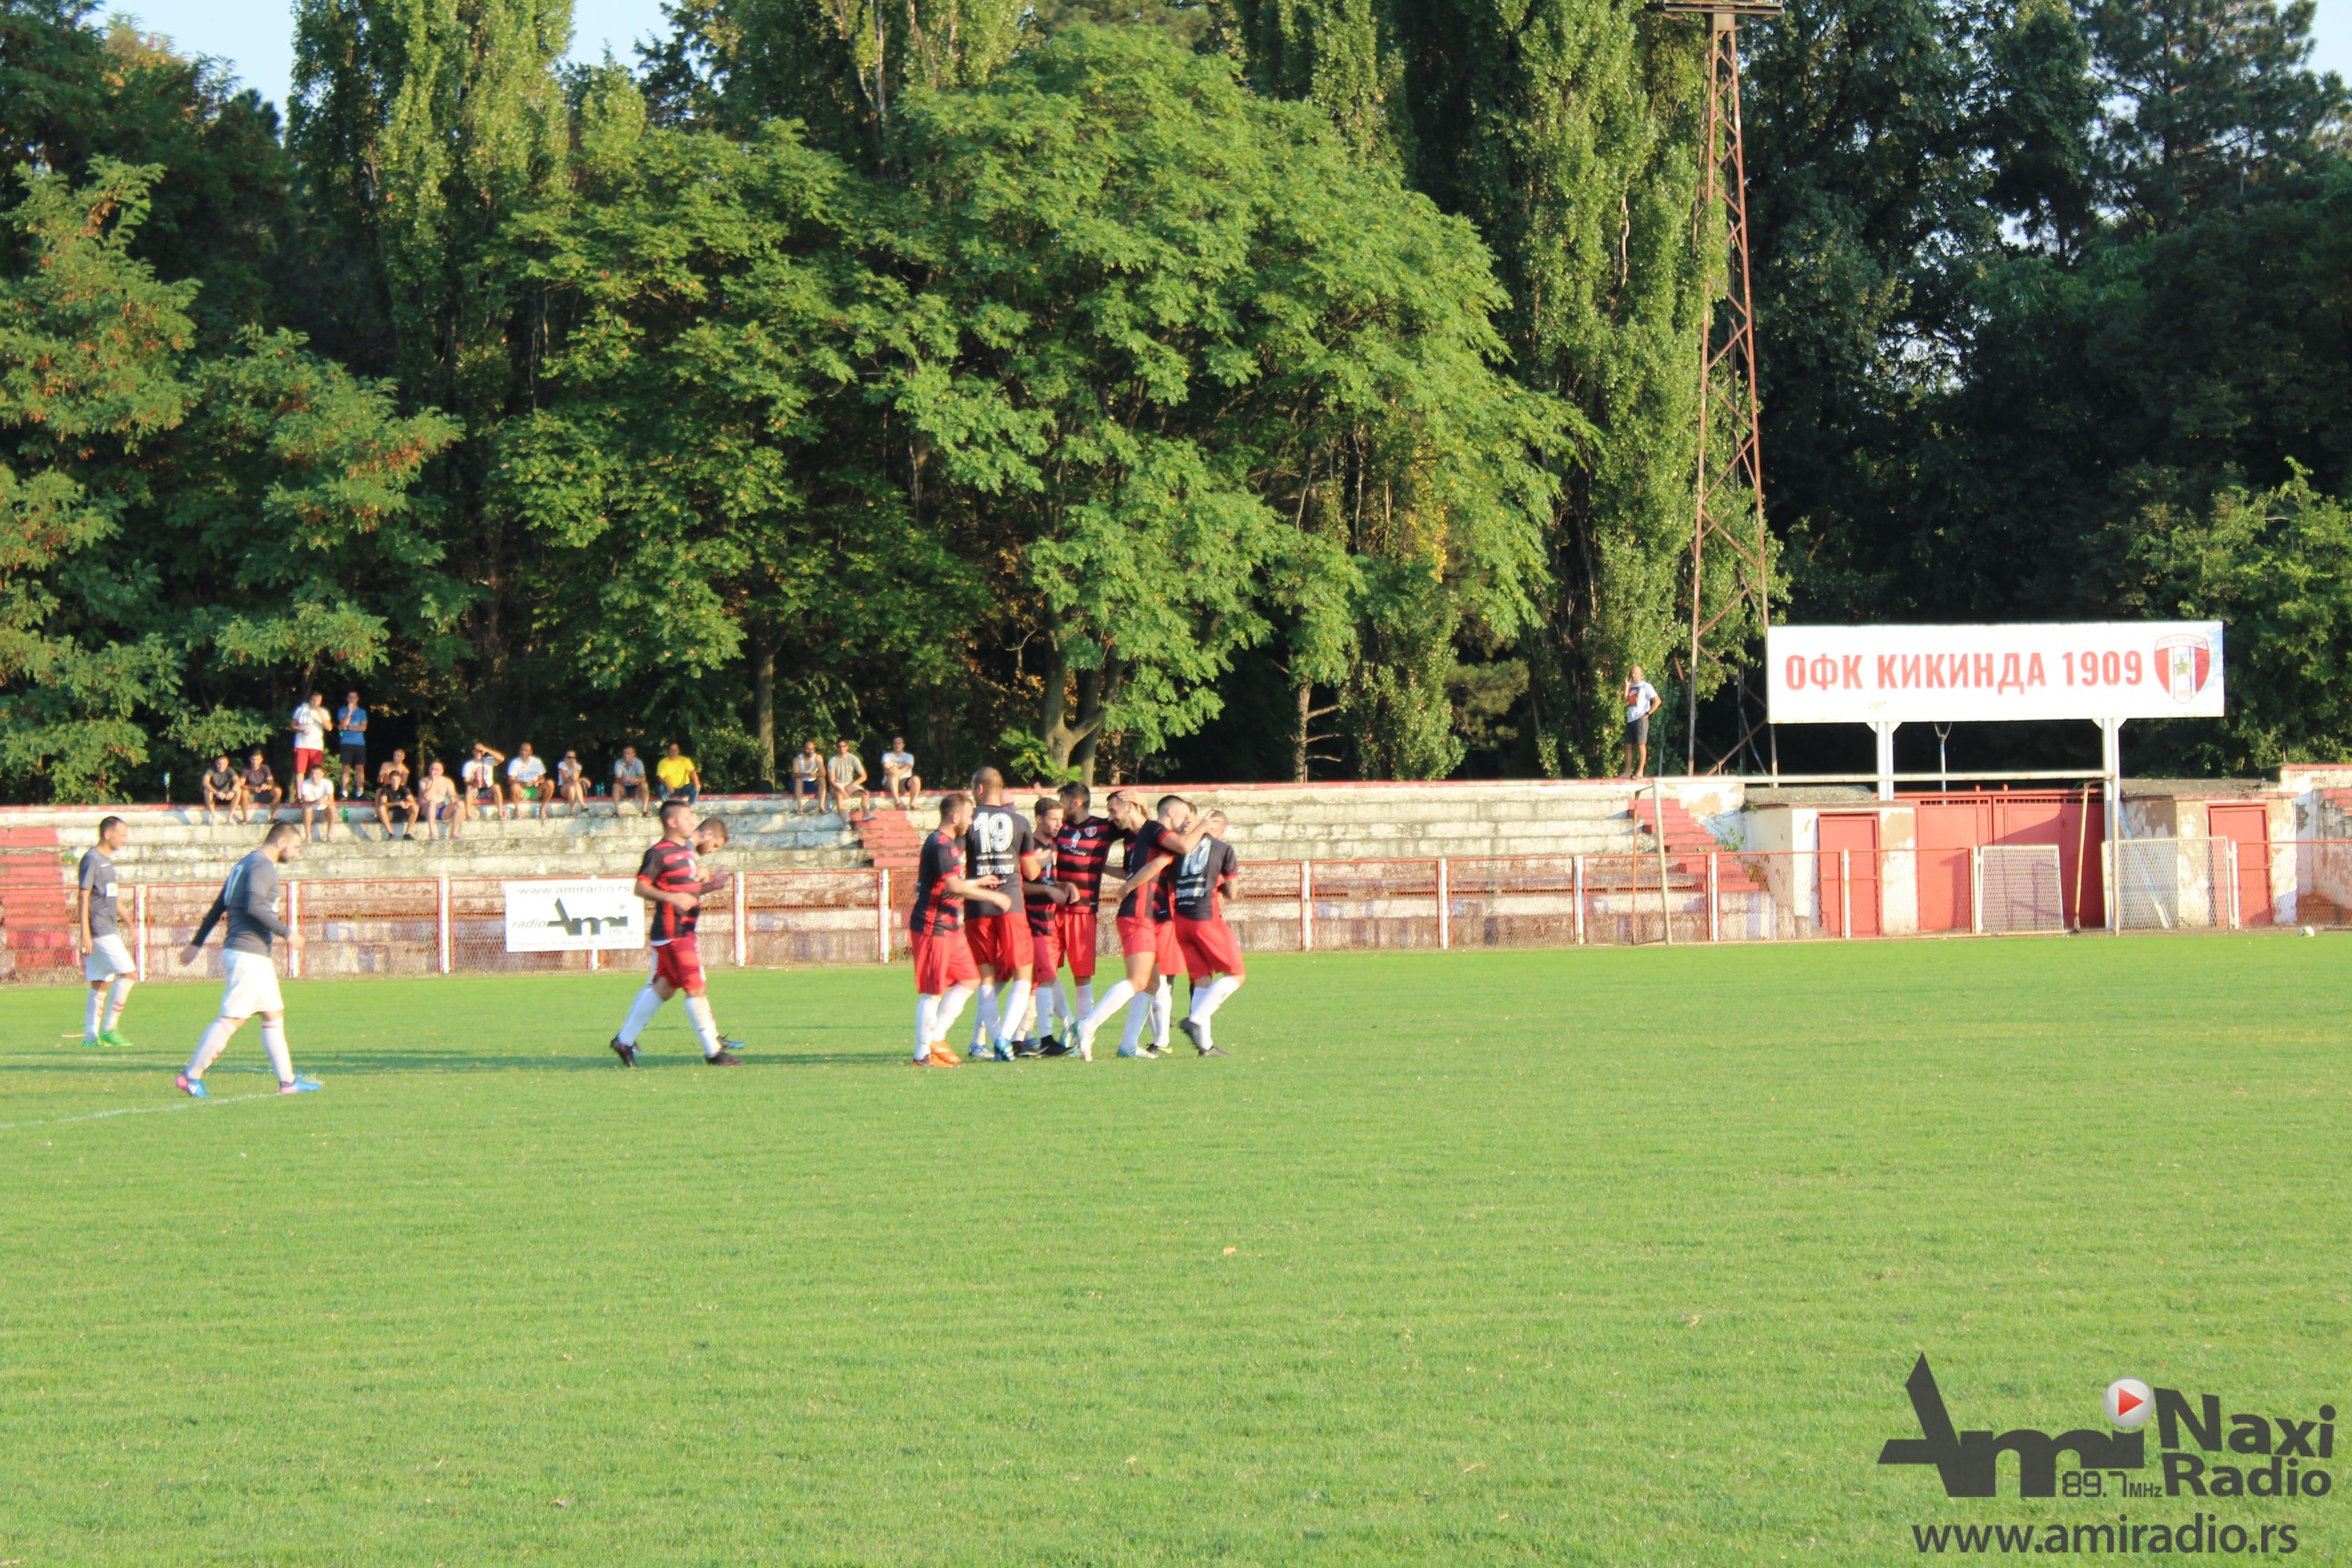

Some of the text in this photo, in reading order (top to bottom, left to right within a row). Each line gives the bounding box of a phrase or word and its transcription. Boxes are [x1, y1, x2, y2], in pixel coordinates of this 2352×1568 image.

[1785, 650, 2142, 695] ОФК КИКИНДА 1909
[974, 812, 1014, 853] 19
[512, 917, 546, 930] radio
